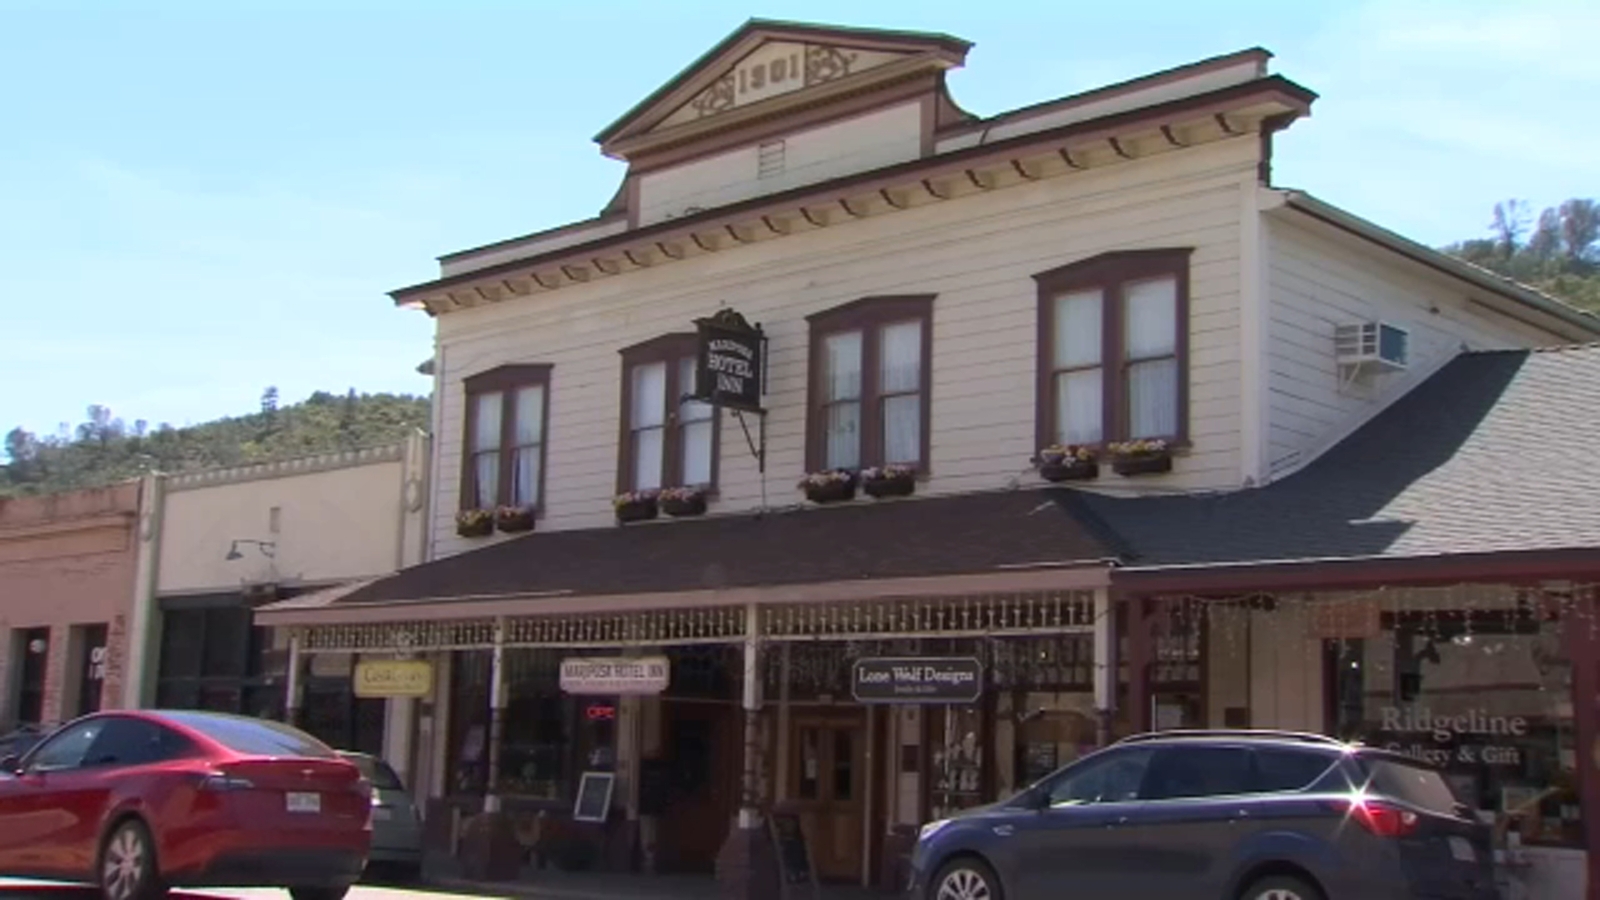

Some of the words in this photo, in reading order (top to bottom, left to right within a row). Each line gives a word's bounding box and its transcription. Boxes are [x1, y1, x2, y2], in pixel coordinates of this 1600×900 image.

[739, 53, 799, 95] 1901
[707, 353, 753, 378] HOTEL
[717, 373, 744, 394] INN
[565, 663, 612, 679] MARIPOSA
[614, 663, 645, 679] HOTEL
[647, 663, 664, 678] INN
[859, 667, 891, 682] Lone
[892, 667, 924, 682] Wolf
[924, 667, 974, 686] Designs
[1380, 706, 1528, 742] Ridgeline
[1457, 745, 1477, 763] &
[1481, 744, 1521, 765] Gift
